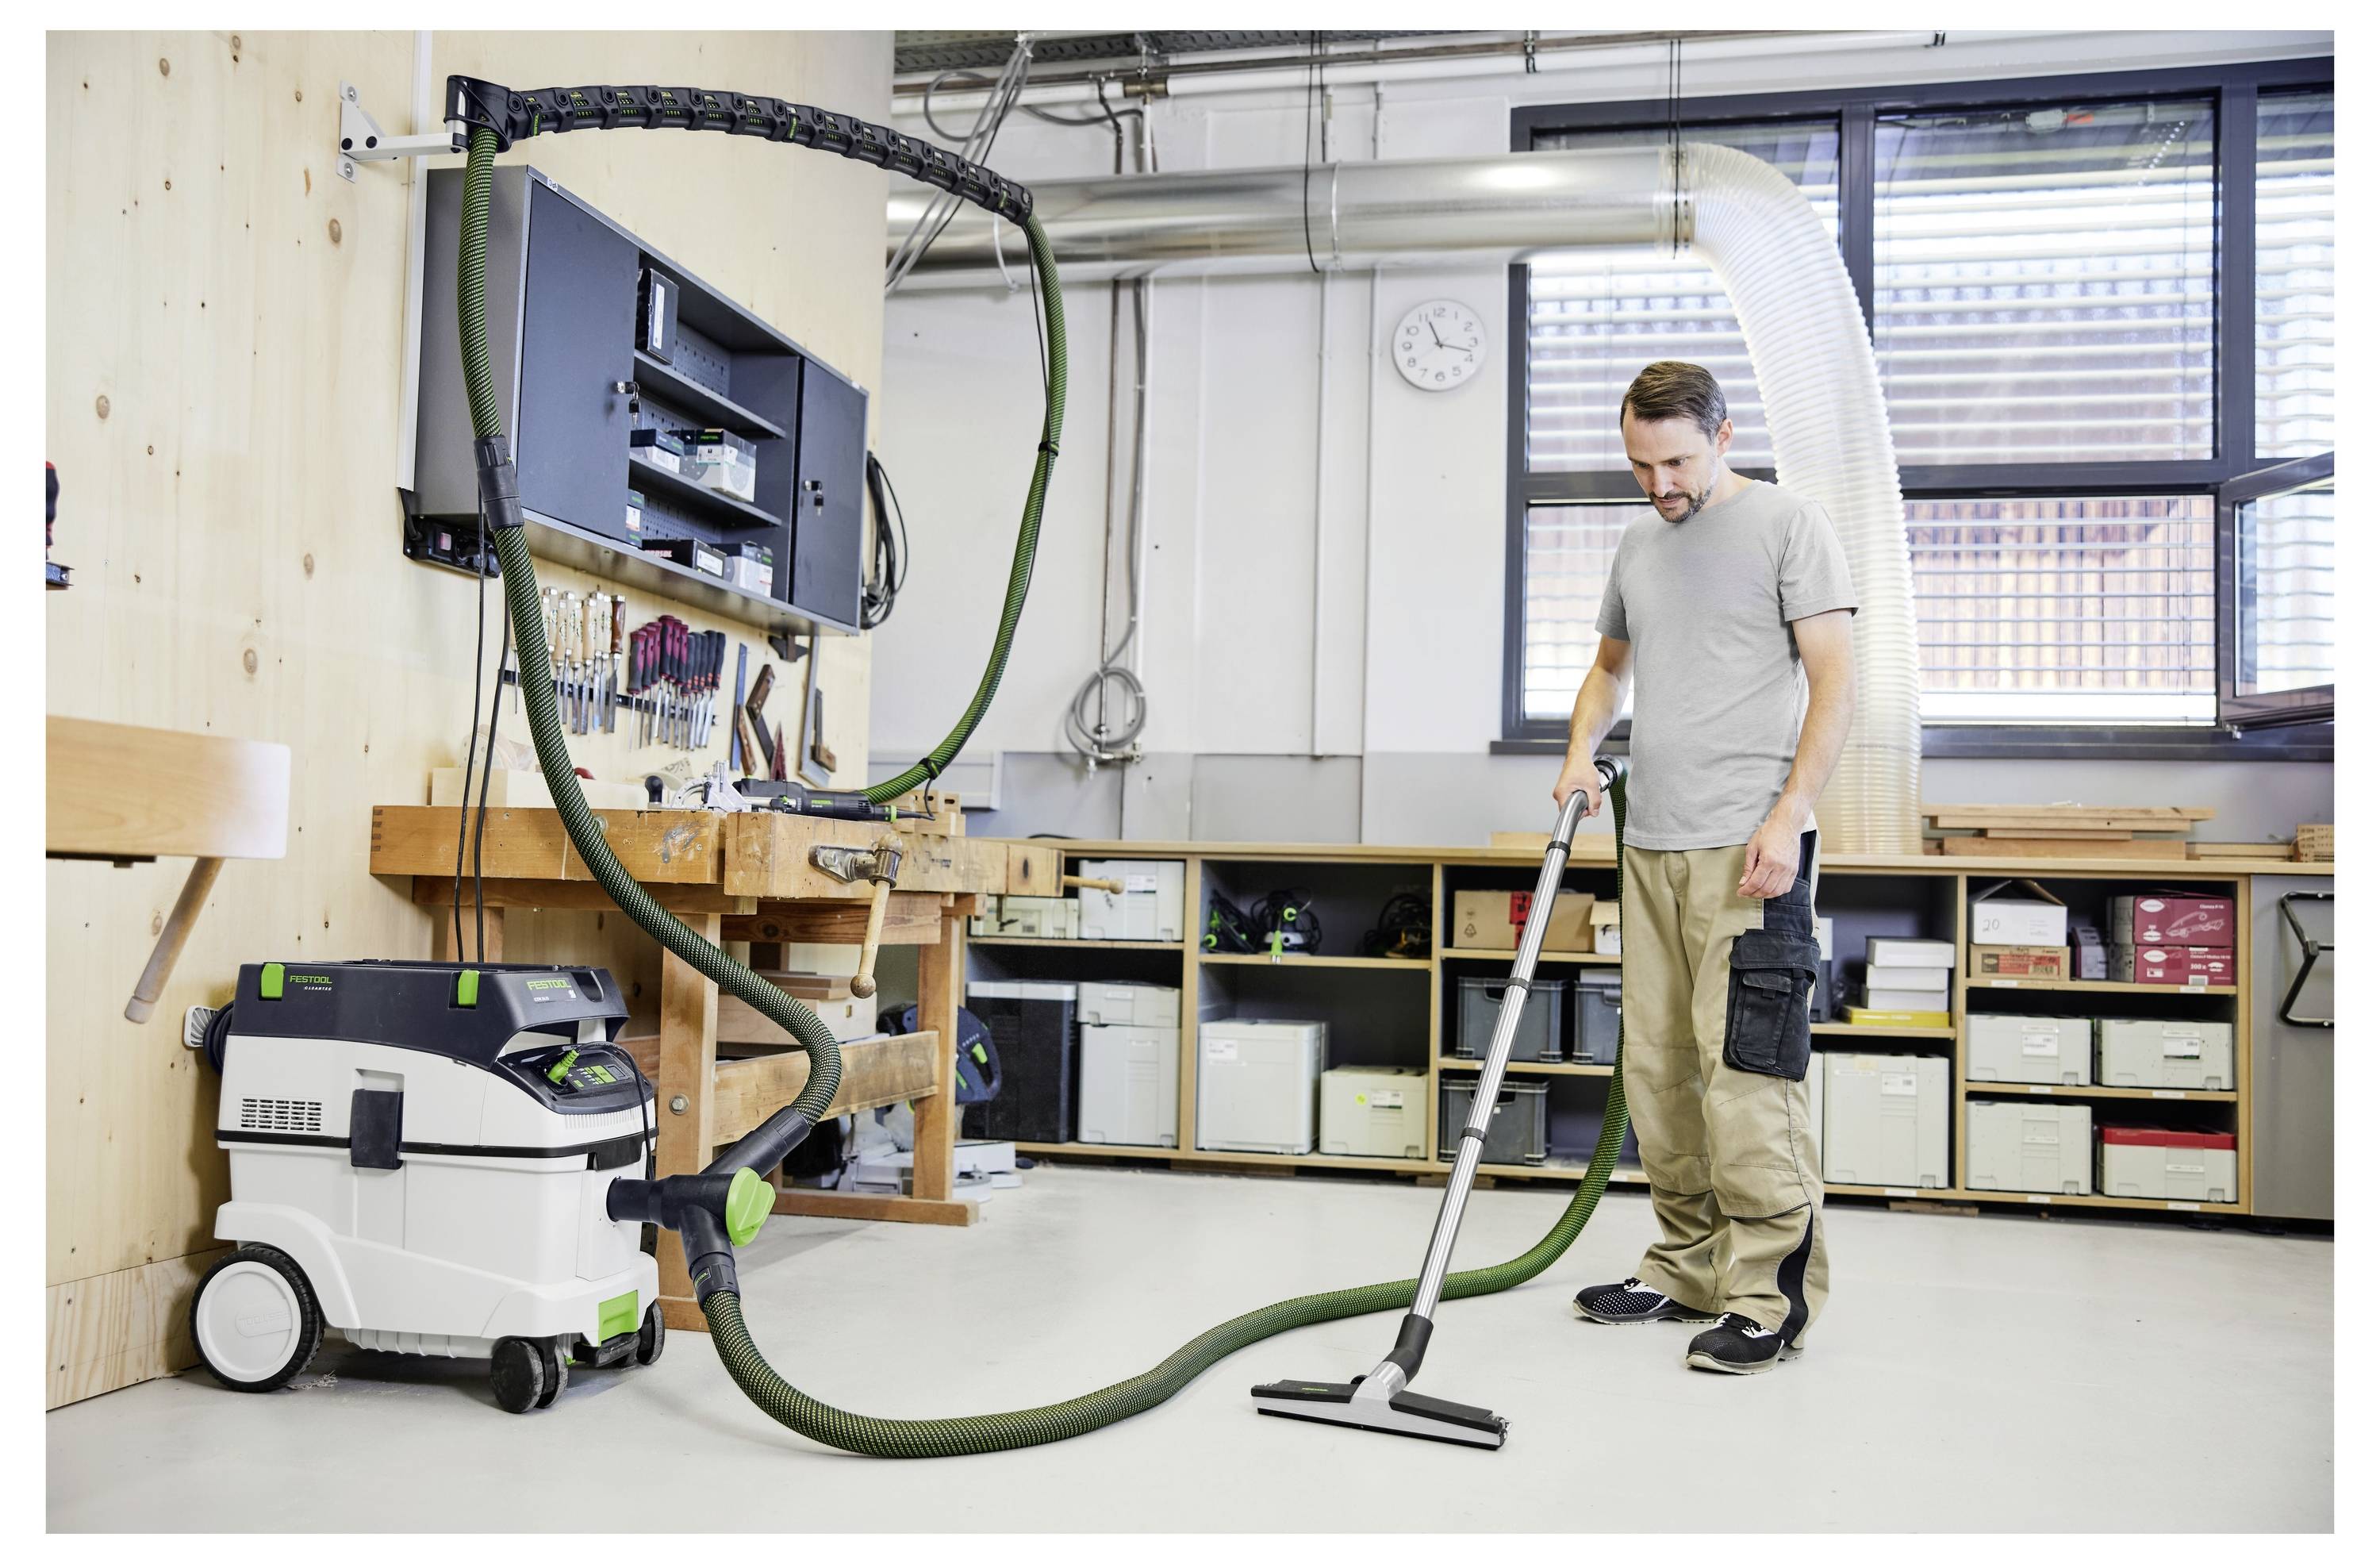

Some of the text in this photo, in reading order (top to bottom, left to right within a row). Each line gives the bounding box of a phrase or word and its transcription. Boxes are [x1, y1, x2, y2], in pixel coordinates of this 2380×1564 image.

[1418, 313, 1428, 322] 11
[1433, 308, 1445, 317] 12
[1406, 325, 1419, 336] 10
[1464, 321, 1473, 332] 2
[1402, 341, 1412, 352] 9
[1468, 336, 1478, 348] 3
[1407, 357, 1416, 368] 8
[1419, 367, 1428, 379] 7
[1434, 371, 1445, 382] 6
[1452, 366, 1461, 376] 5
[1983, 918, 2000, 932] 20
[290, 975, 333, 984] FESTOOL
[527, 980, 571, 990] FESTOOL
